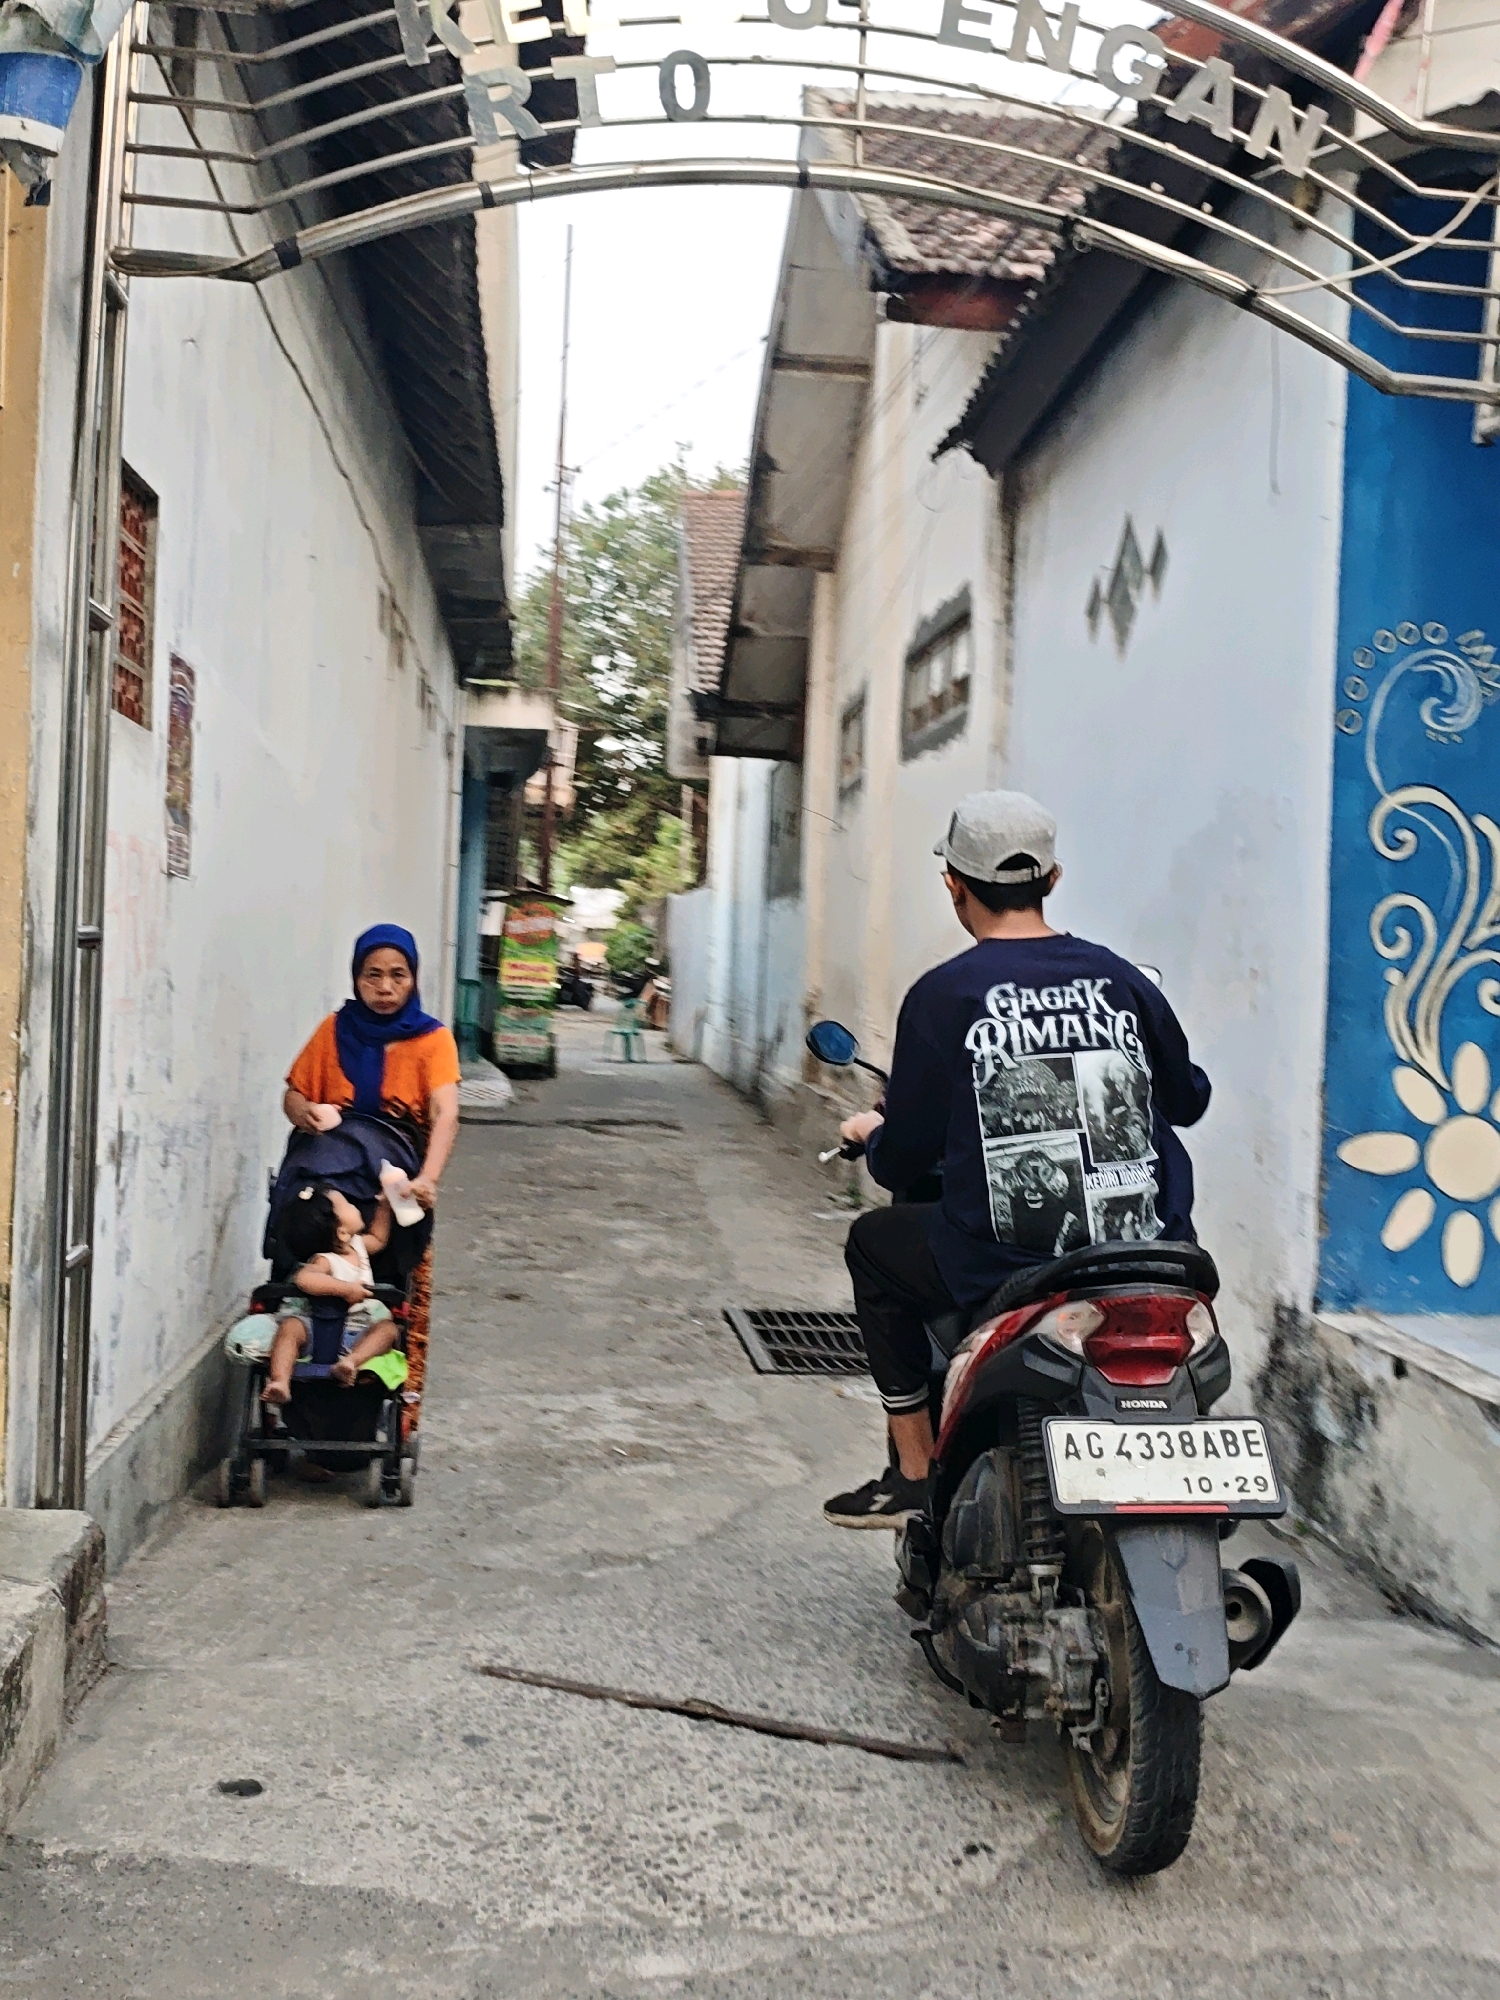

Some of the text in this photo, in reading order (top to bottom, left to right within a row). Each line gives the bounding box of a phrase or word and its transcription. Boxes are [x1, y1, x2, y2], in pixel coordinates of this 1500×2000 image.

[984, 977, 1115, 1021] GAGAK
[965, 1010, 1153, 1089] RIMANG
[1120, 1400, 1168, 1409] HONDA
[1065, 1431, 1104, 1461] AG
